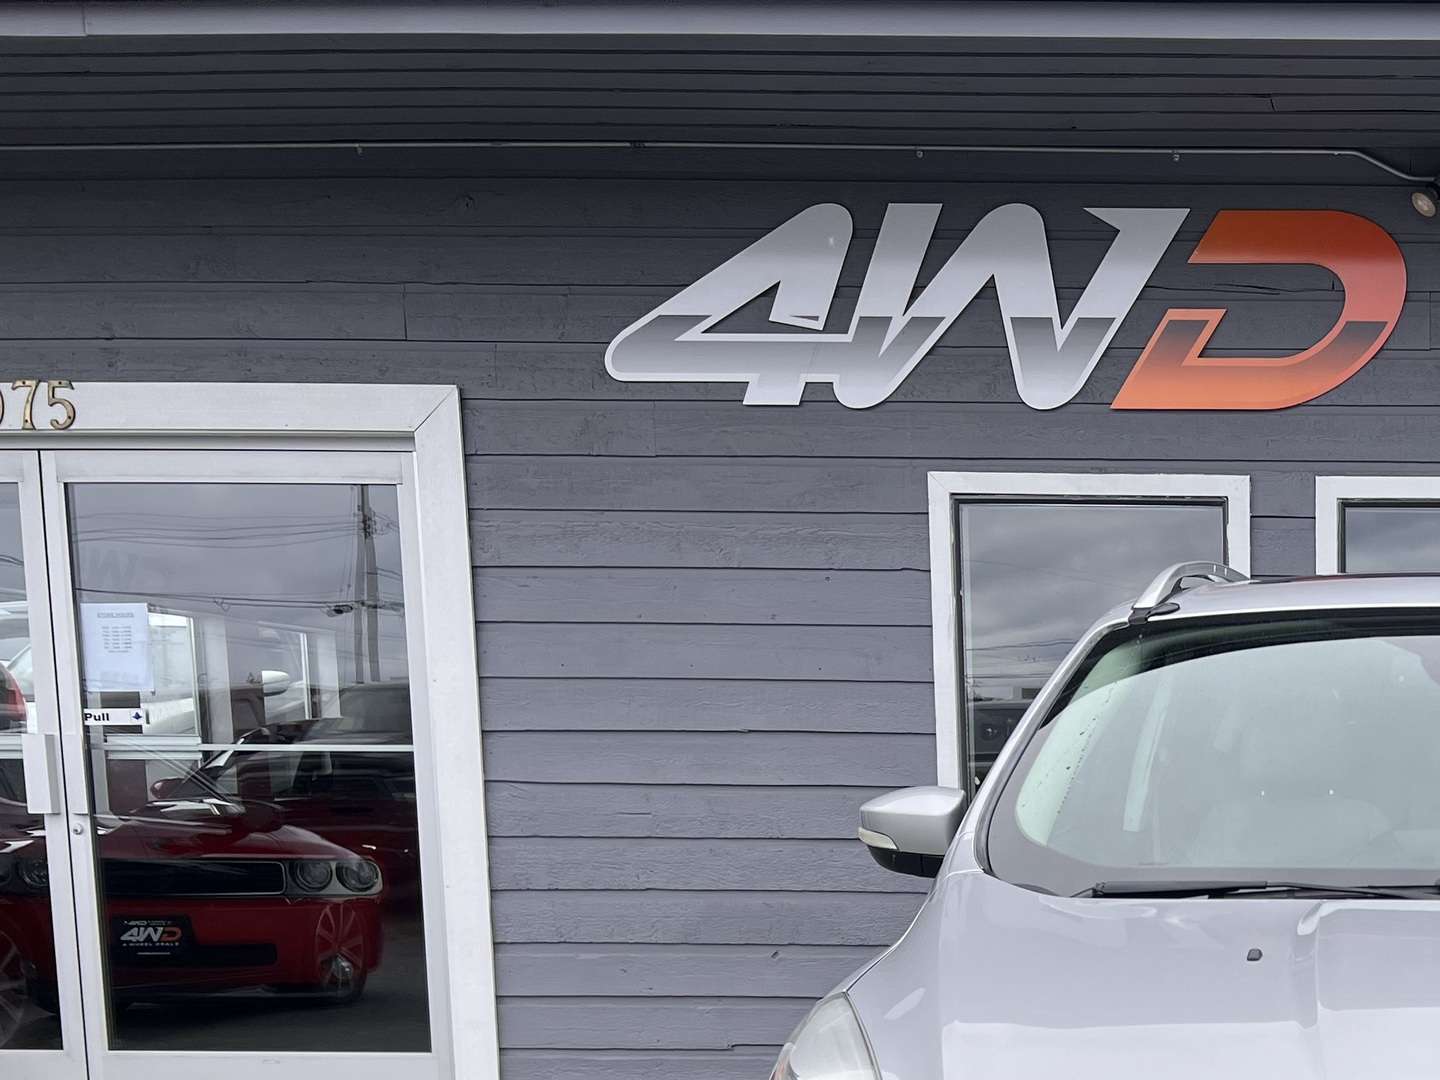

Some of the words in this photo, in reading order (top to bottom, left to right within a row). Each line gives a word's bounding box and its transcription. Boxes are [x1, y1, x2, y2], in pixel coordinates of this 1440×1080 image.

[604, 203, 1408, 410] 4WD
[0, 380, 77, 431] 75
[83, 711, 111, 722] Pull
